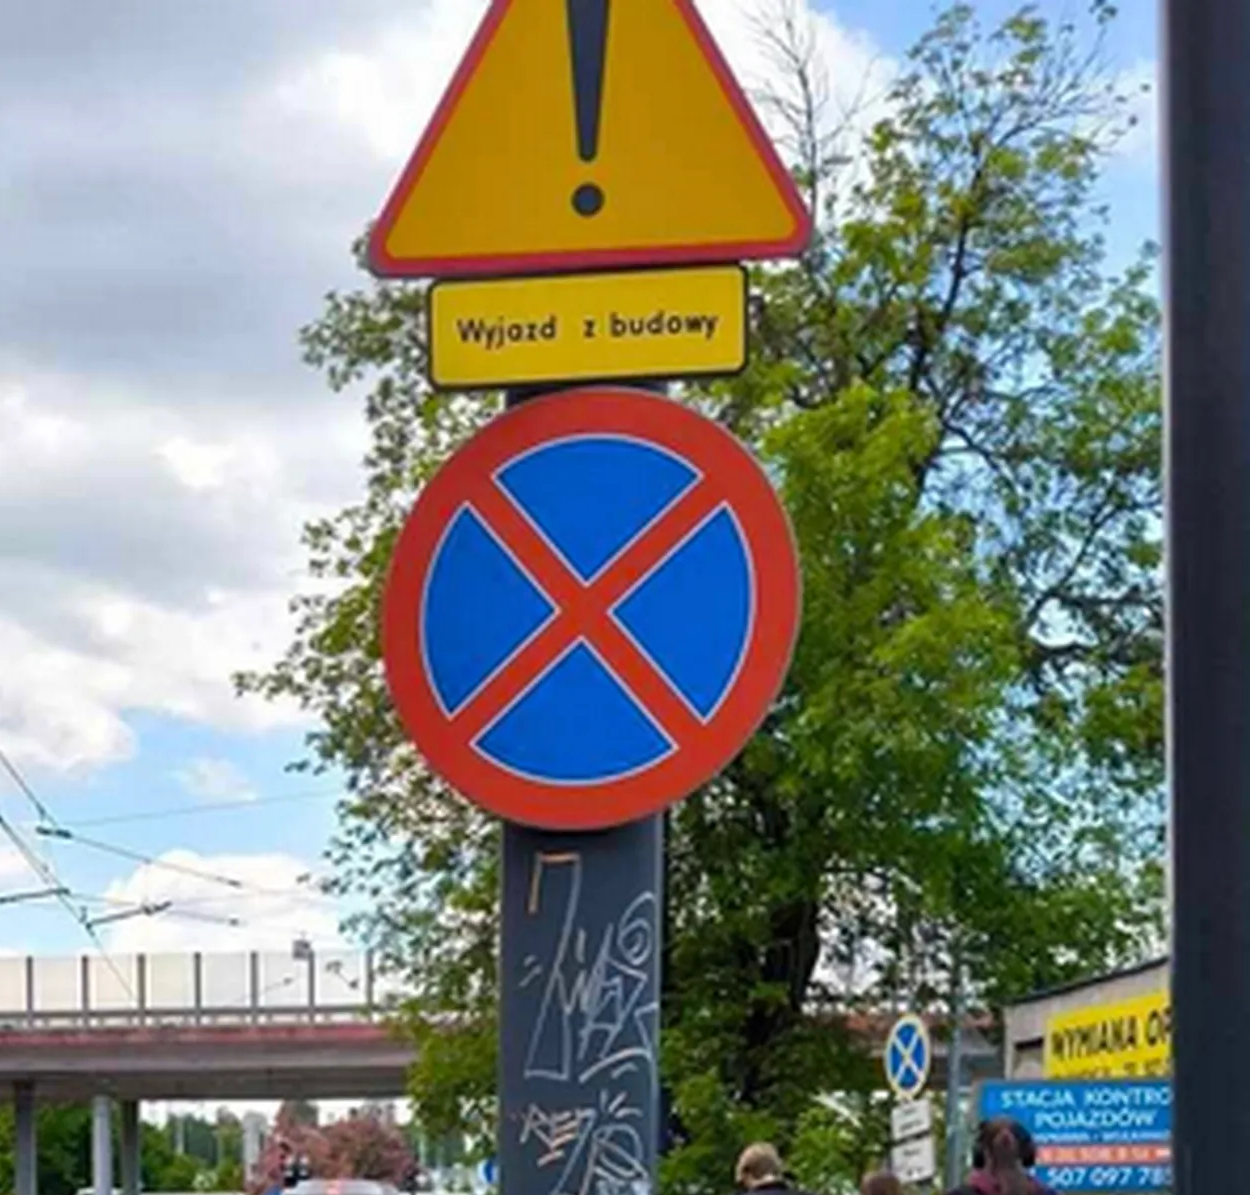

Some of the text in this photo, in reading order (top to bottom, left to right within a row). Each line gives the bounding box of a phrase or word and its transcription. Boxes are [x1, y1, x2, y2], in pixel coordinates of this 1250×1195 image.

[456, 310, 720, 351] Wyjazd z budowy
[1052, 1015, 1138, 1061] WYMIANA
[1001, 1088, 1076, 1108] STACJA
[1035, 1108, 1157, 1128] POJAZDÓW
[1048, 1166, 1086, 1187] 507
[1089, 1166, 1132, 1187] 097
